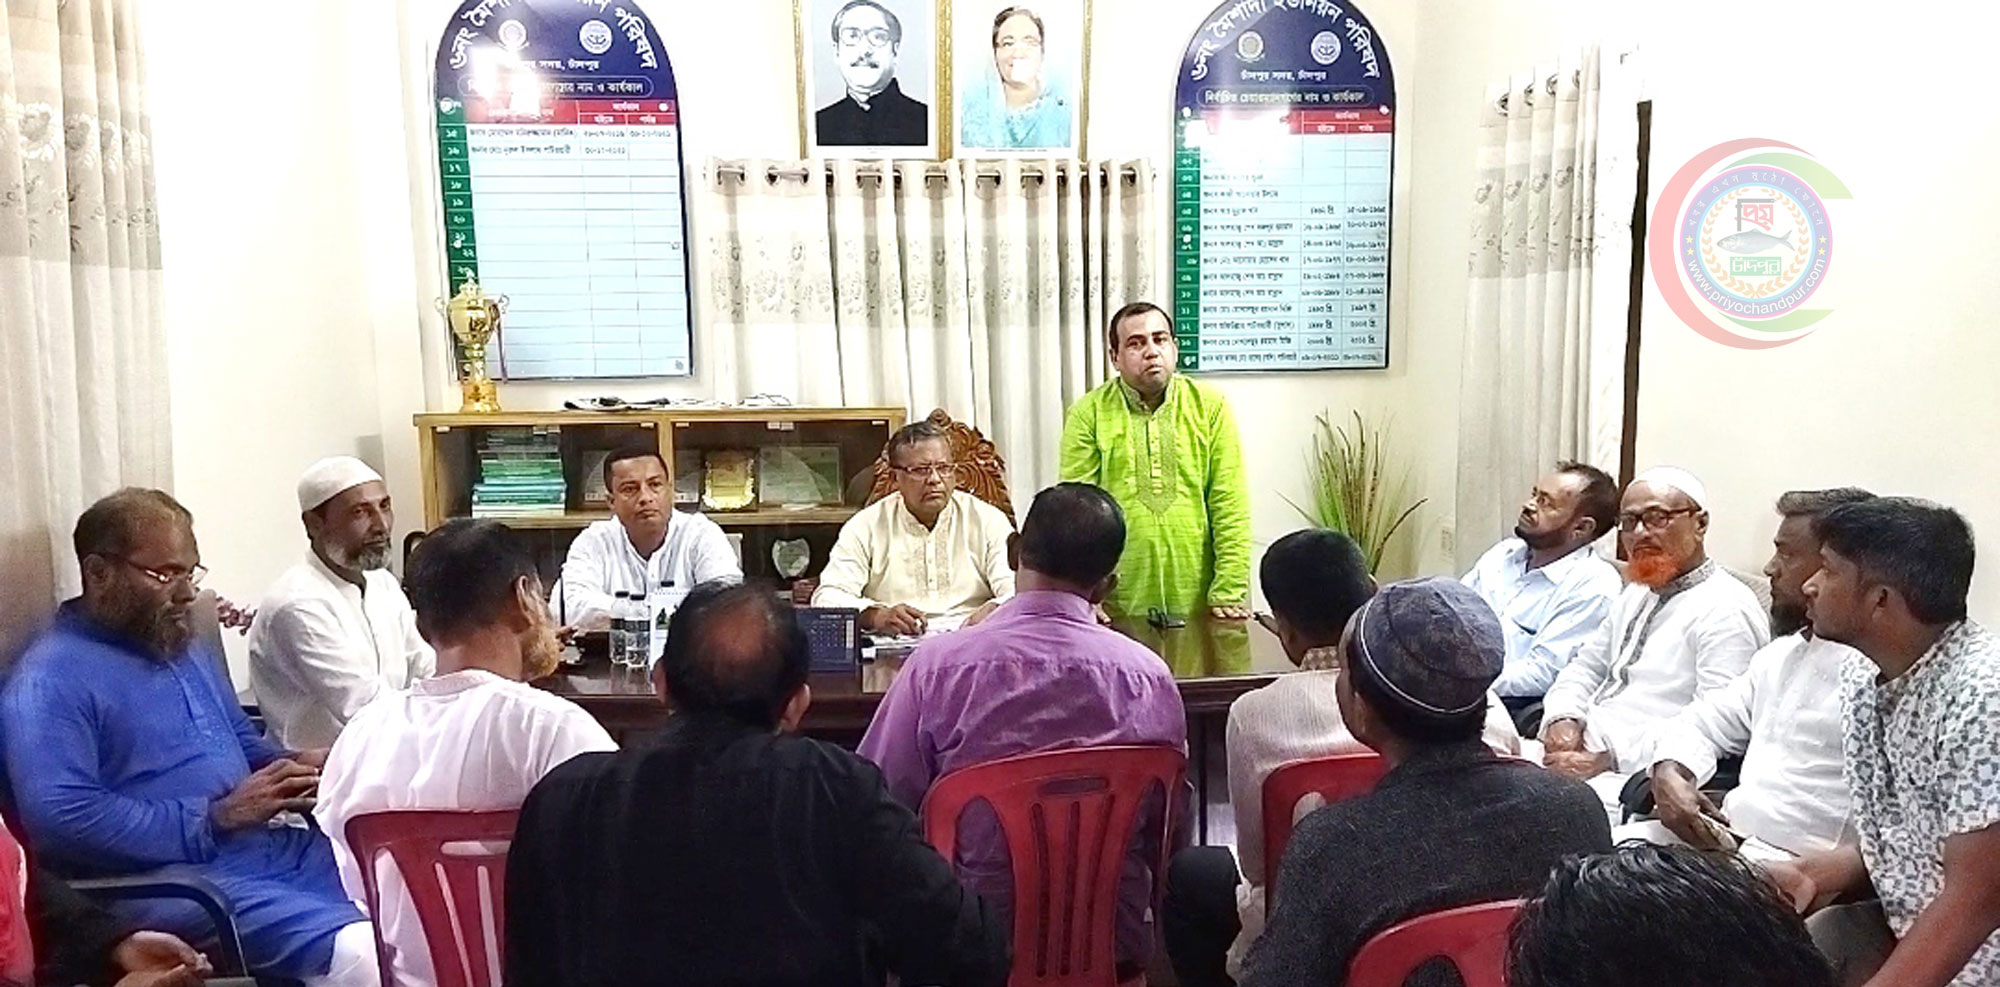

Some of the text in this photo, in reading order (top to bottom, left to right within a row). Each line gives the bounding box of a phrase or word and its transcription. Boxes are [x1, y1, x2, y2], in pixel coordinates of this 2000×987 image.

[613, 6, 658, 69] পরিষদ
[1191, 40, 1221, 80] ৬নং
[1344, 17, 1381, 79] পরিষদ
[568, 59, 600, 71] চাঁদপুর
[1240, 70, 1327, 81] চাঁদপুর সদর, চাঁদপুর
[607, 79, 643, 93] কার্যকাল
[1205, 89, 1238, 103] নির্বাচিত
[1304, 92, 1319, 102] নাম
[1322, 93, 1331, 102] ও
[1333, 89, 1365, 102] কার্যকাল
[446, 128, 458, 138] ১৫
[447, 146, 460, 156] ১৬
[449, 163, 461, 173] ১৭
[454, 215, 466, 224] ২০
[462, 249, 475, 258] ২২
[1181, 290, 1192, 298] ১০
[1181, 307, 1190, 315] ১১
[1181, 323, 1191, 331] ১২
[1181, 339, 1191, 347] ১৩
